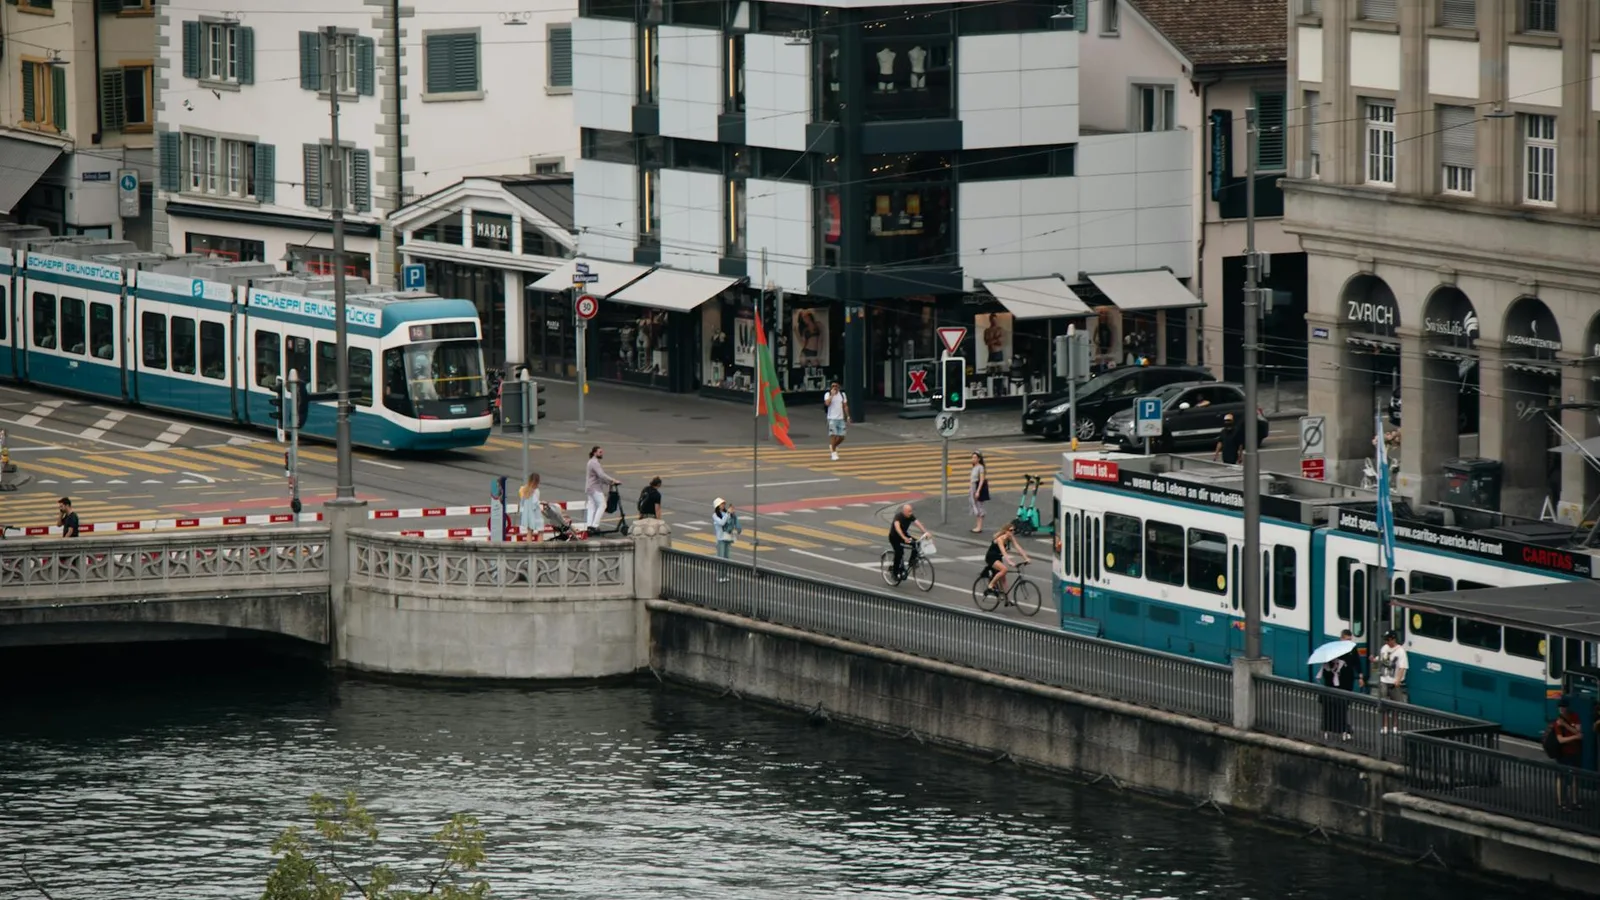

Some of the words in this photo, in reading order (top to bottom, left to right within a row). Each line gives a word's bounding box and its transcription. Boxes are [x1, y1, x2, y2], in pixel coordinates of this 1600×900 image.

[476, 222, 508, 239] MAREA
[28, 256, 64, 271] SCHAEPPI
[65, 263, 120, 280] GRUNDSTÜCKE
[410, 269, 420, 285] P
[254, 293, 301, 311] SCHAEPPI
[304, 302, 376, 325] GRUNDÜCKE
[583, 302, 592, 312] 30
[1145, 402, 1155, 418] P
[941, 416, 955, 430] 30
[1075, 462, 1097, 477] Armut
[1097, 464, 1108, 478] ist
[1132, 477, 1151, 490] wenn
[1152, 479, 1165, 492] das
[1166, 481, 1187, 496] Leben
[1188, 487, 1197, 498] an
[1198, 487, 1208, 500] dir
[1210, 490, 1244, 507] vorbeifäh
[1340, 513, 1358, 528] Jetzt
[1522, 545, 1573, 570] CARITAS
